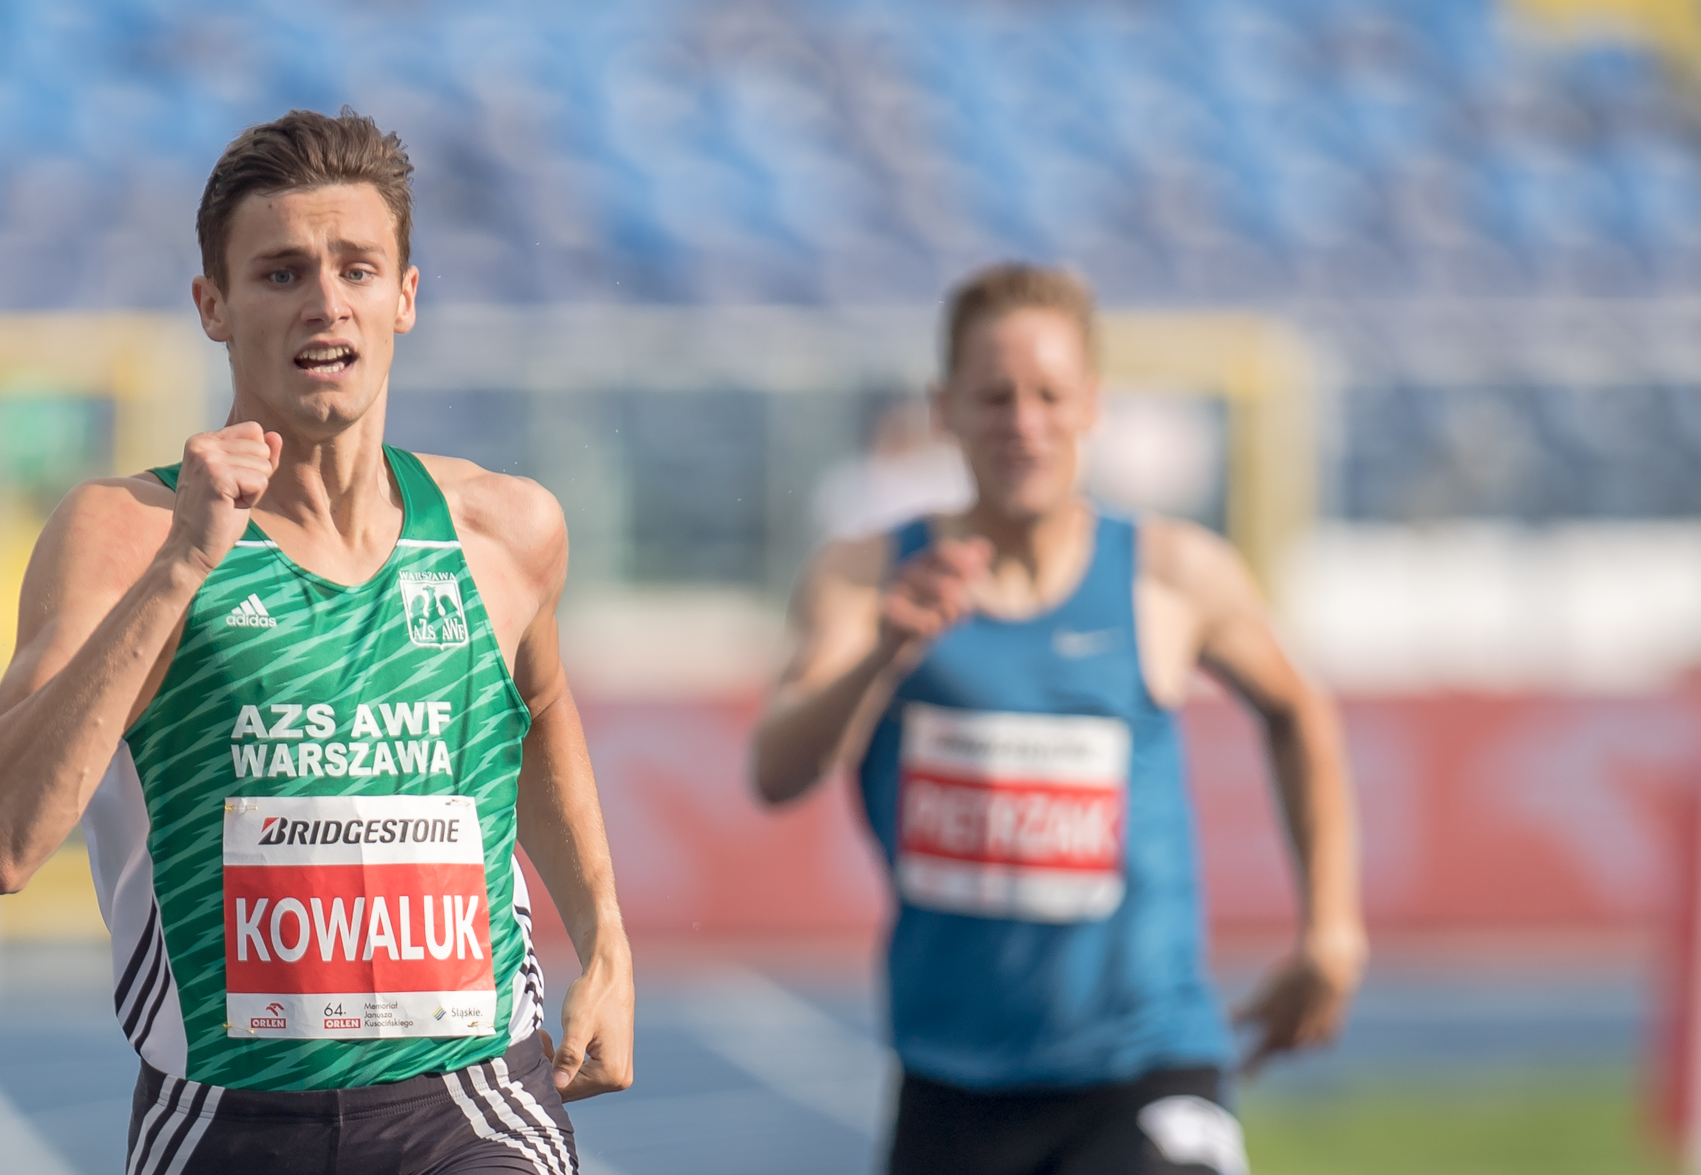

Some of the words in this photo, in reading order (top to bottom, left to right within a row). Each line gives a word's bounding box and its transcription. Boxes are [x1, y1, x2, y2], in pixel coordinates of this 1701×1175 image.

[398, 570, 457, 581] WARSZAWA
[225, 613, 277, 629] adidas
[413, 618, 437, 640] AZS
[442, 618, 465, 641] AWF
[230, 703, 337, 739] AZS
[350, 701, 452, 739] AWF
[230, 740, 453, 778] WARSZAWA
[258, 817, 460, 846] BRIDGESTONE
[235, 895, 485, 963] KOWALUK
[323, 1003, 347, 1017] 64.
[251, 1019, 286, 1029] ORLEN
[325, 1019, 361, 1028] ORLEN
